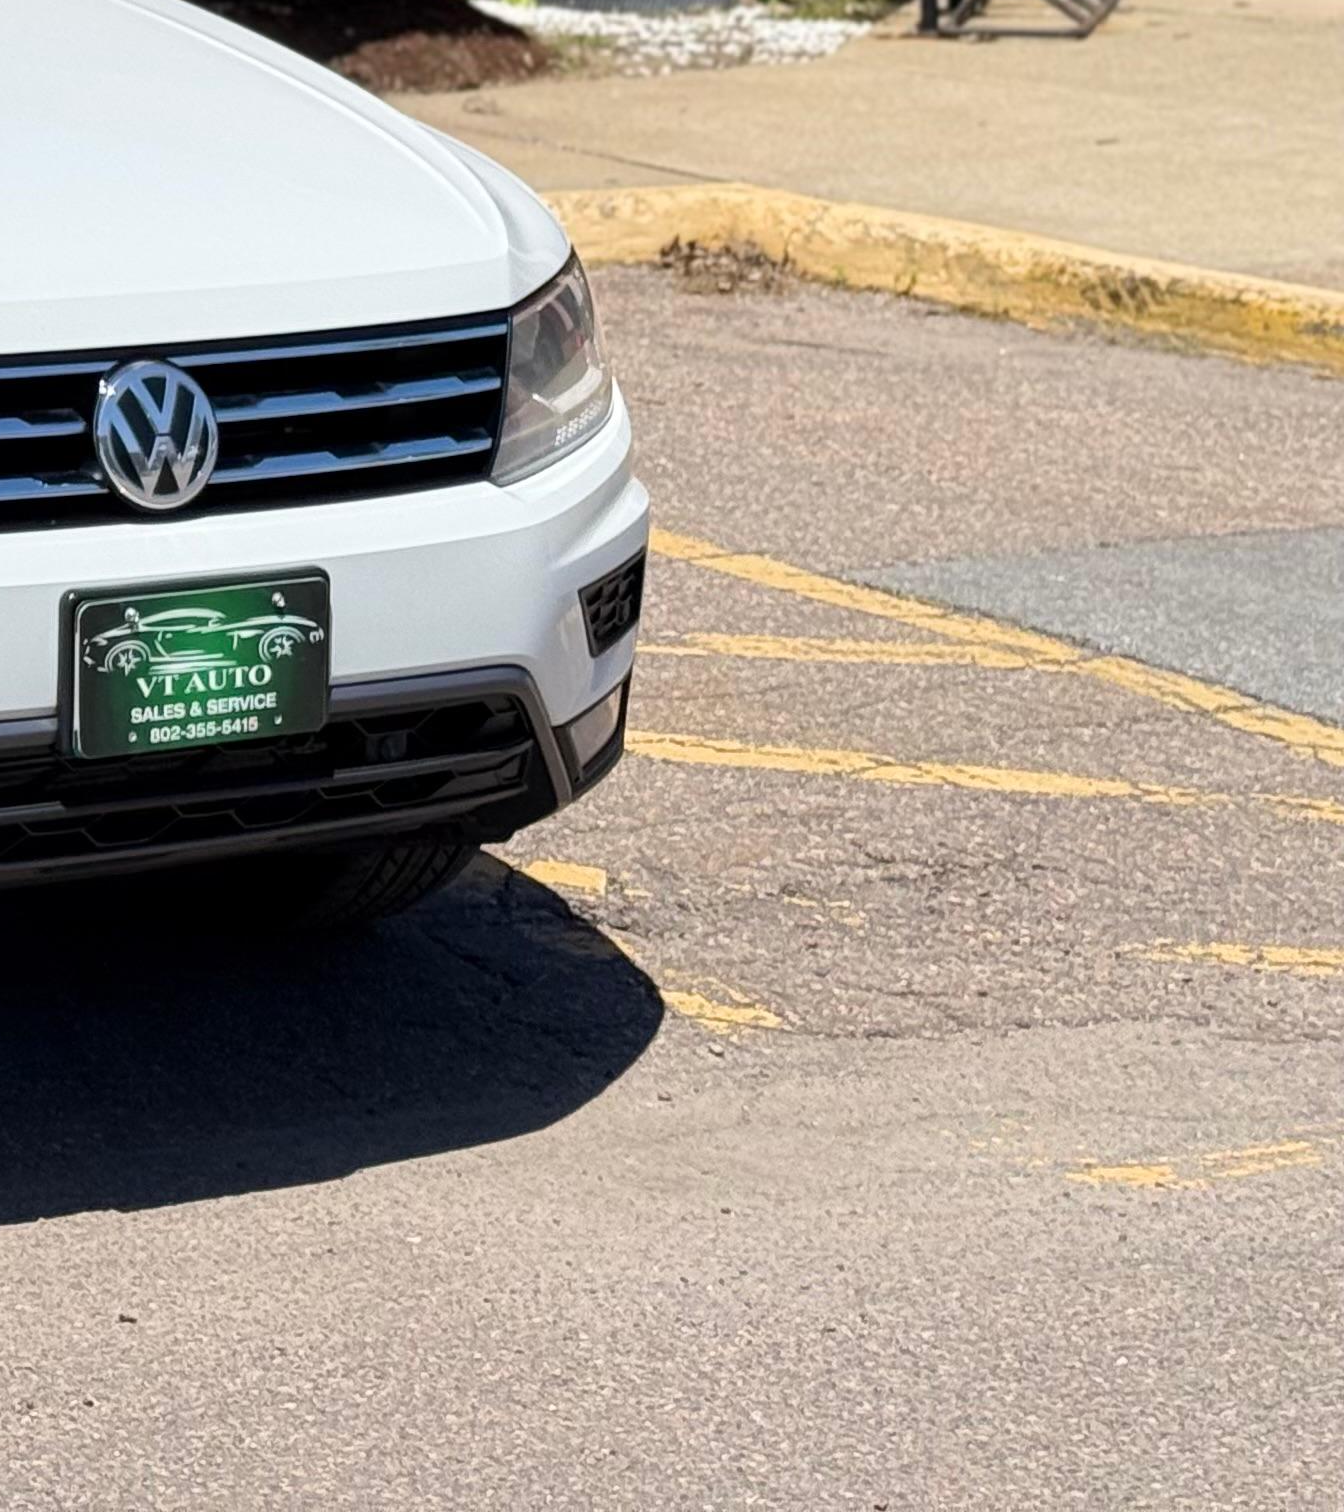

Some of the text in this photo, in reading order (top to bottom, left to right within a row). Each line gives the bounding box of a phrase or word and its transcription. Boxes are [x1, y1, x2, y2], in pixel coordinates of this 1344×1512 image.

[130, 691, 278, 724] SALES & SERVICE
